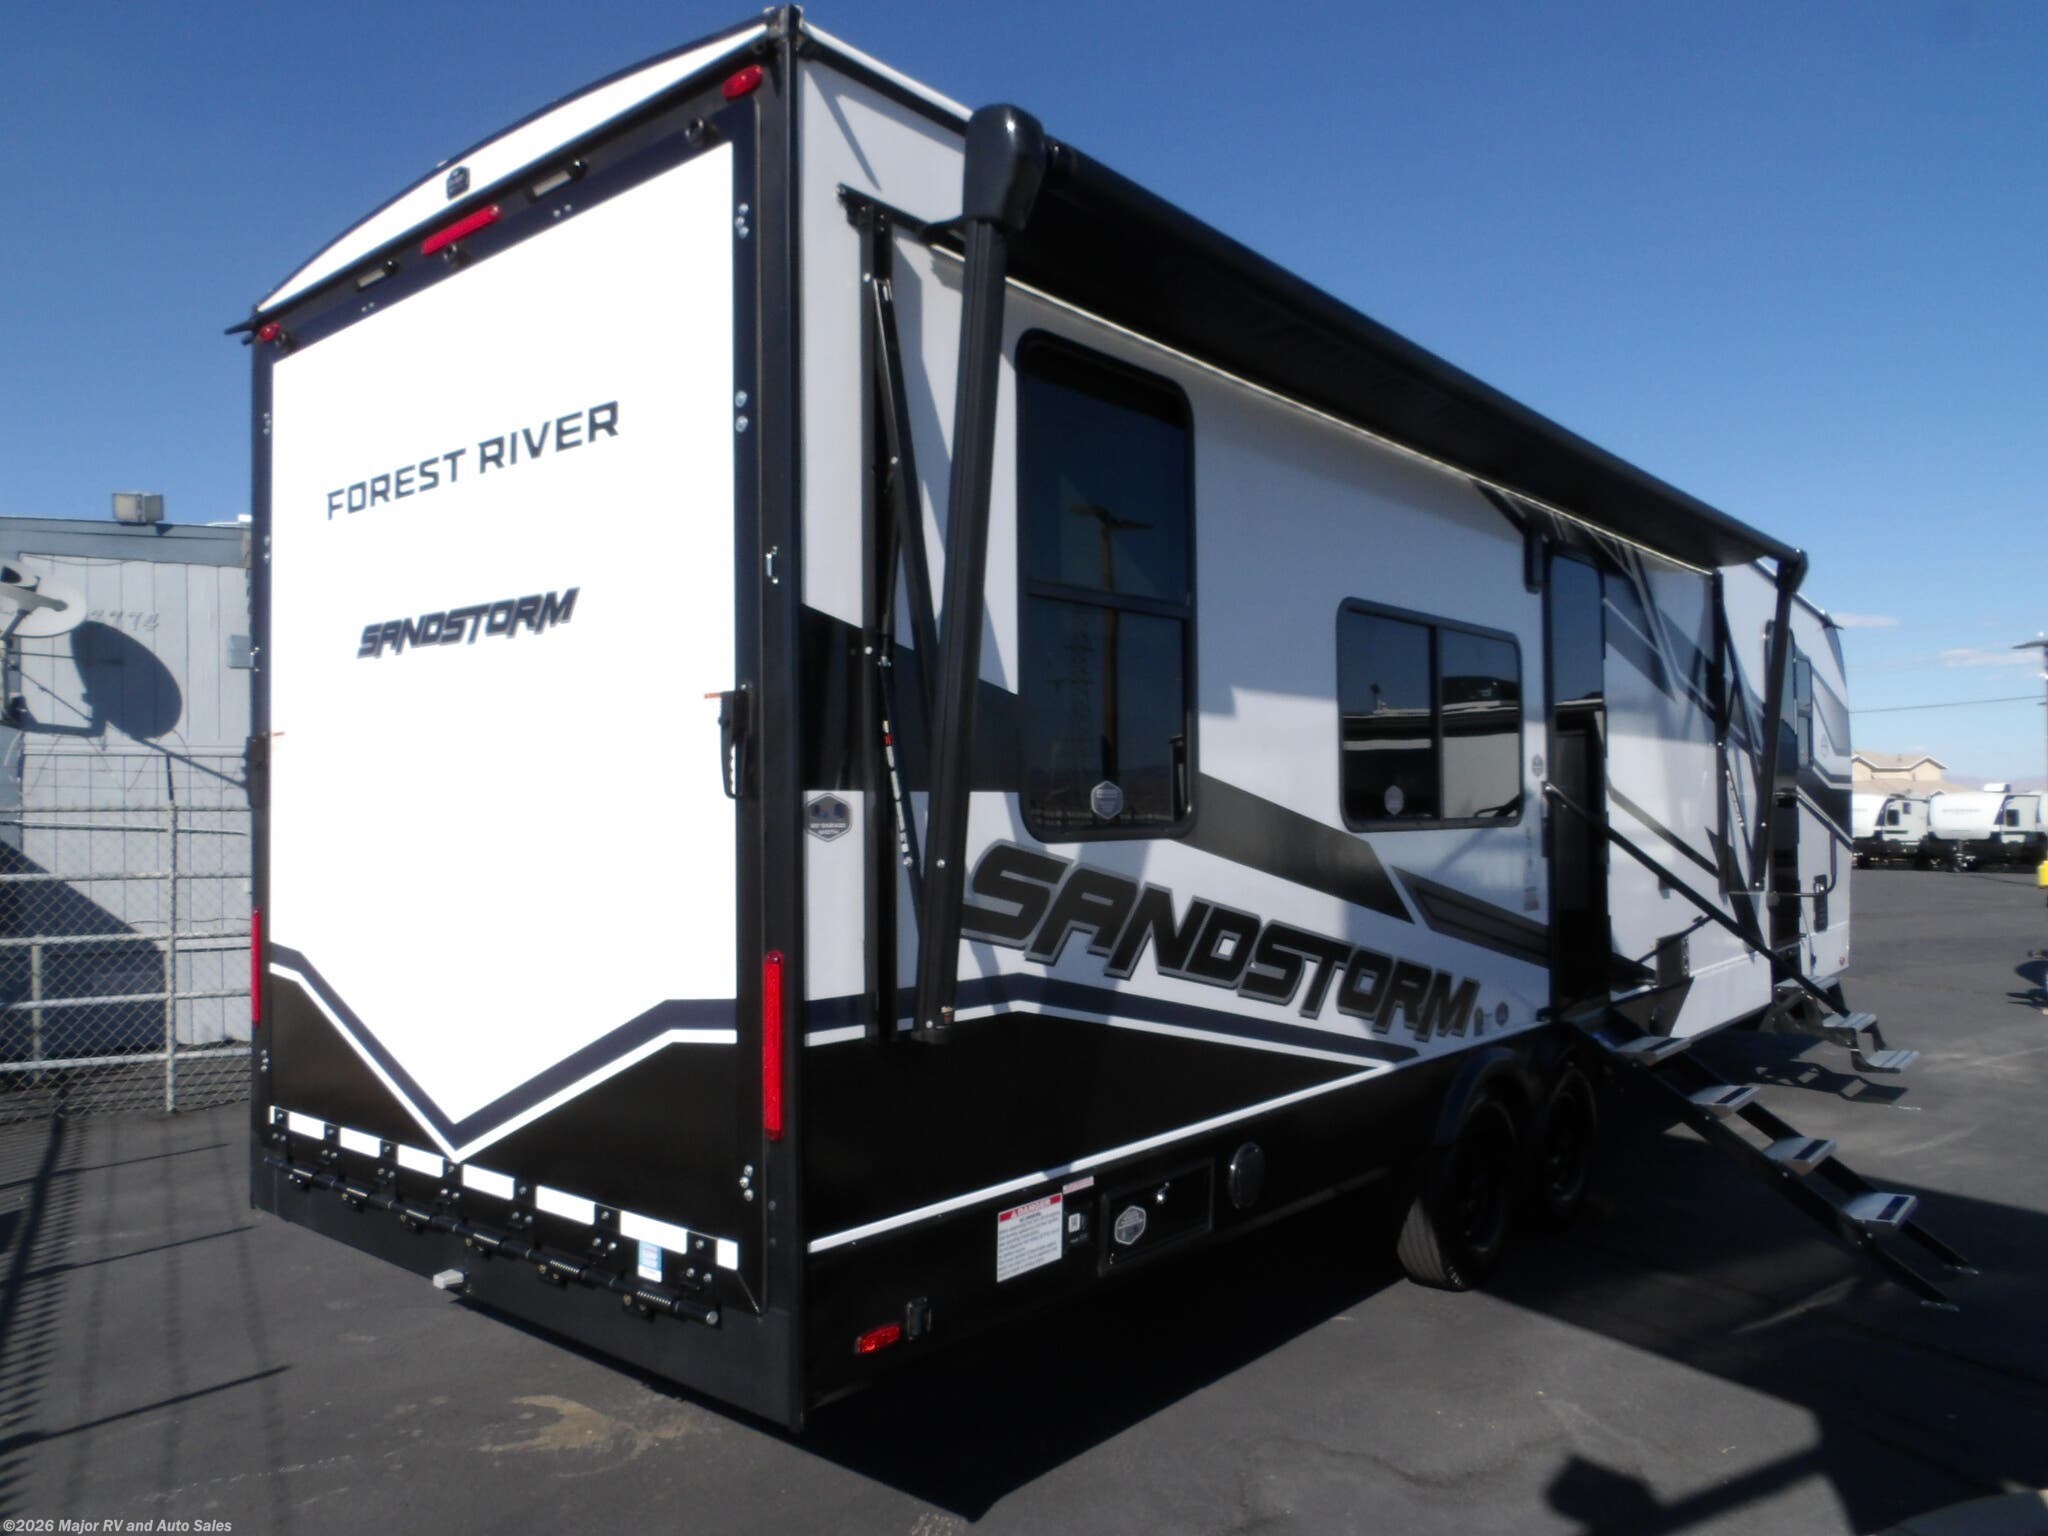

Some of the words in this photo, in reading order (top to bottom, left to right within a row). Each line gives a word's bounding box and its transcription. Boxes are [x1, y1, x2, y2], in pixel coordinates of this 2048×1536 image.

[326, 447, 467, 521] FOREST
[478, 400, 620, 474] RIVER
[356, 586, 581, 660] SANDSTORM
[961, 838, 1481, 1042] SANDSTORM
